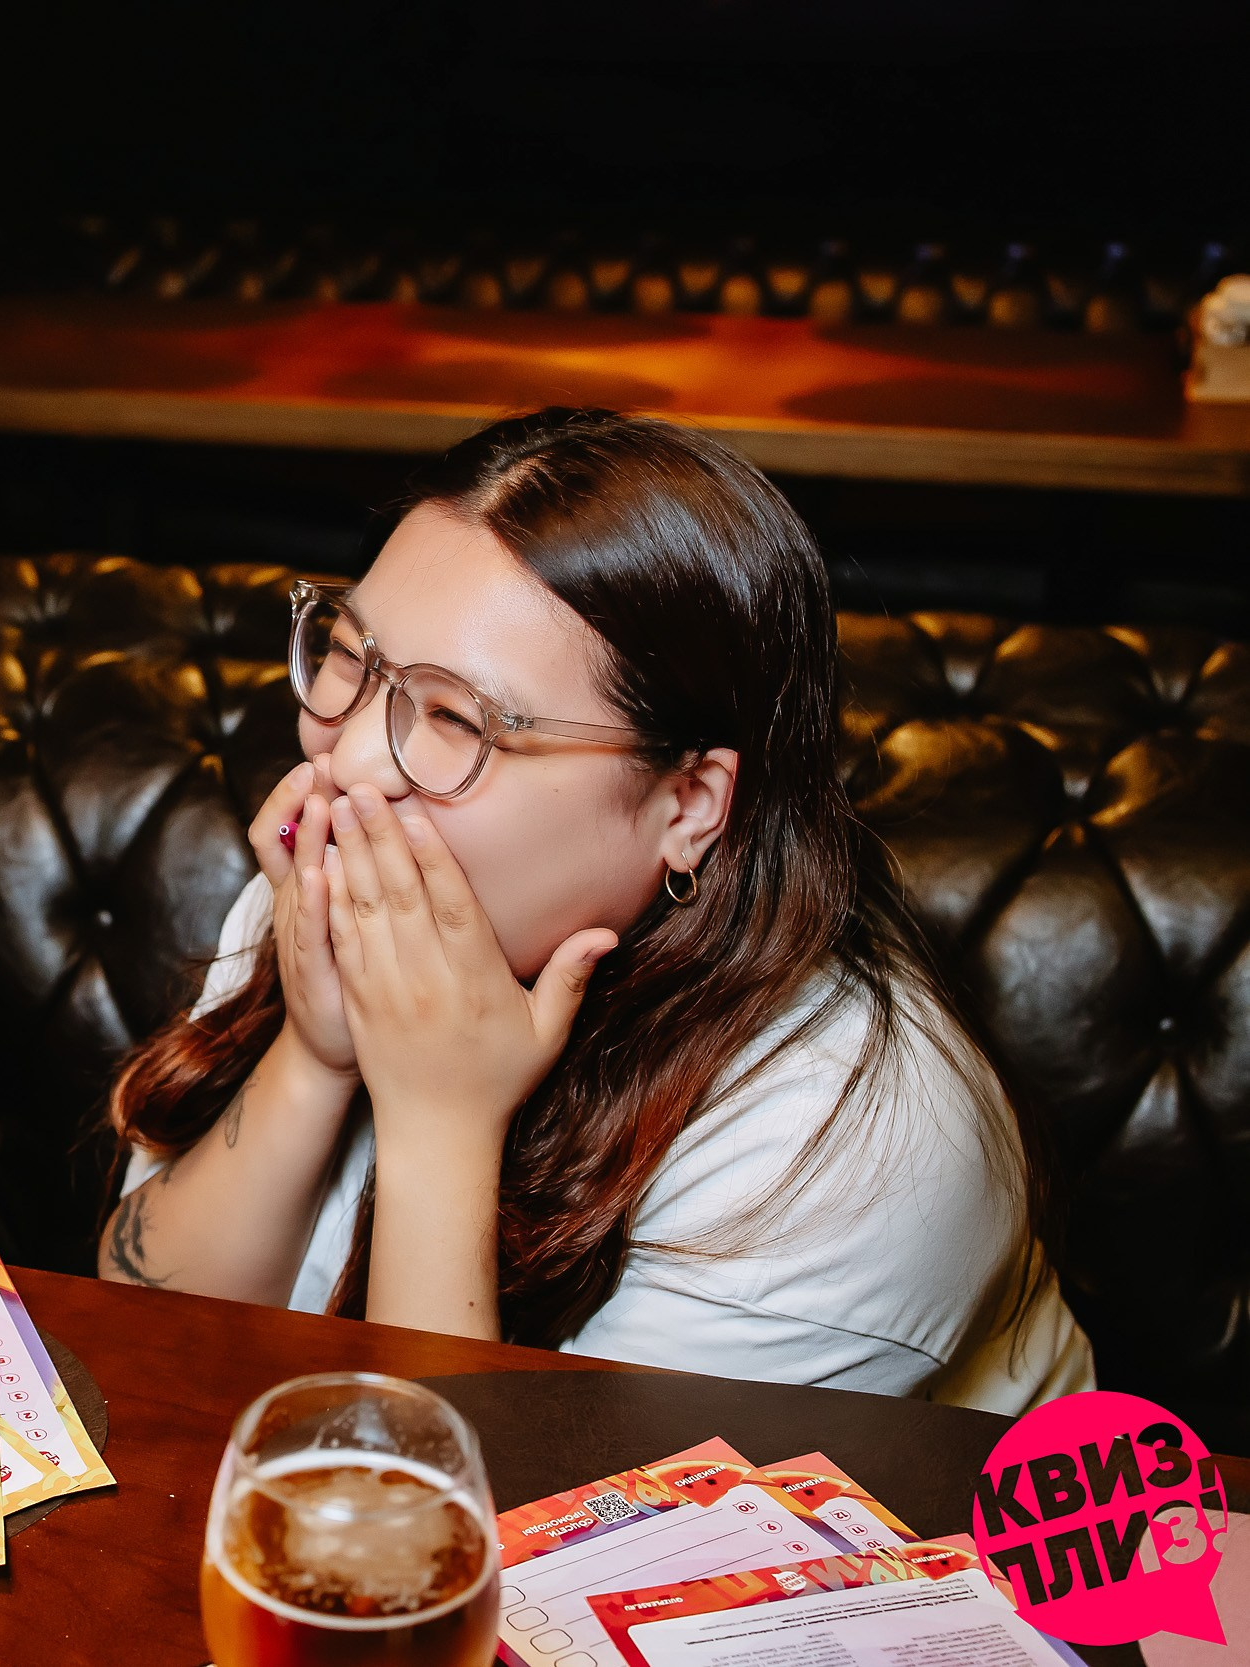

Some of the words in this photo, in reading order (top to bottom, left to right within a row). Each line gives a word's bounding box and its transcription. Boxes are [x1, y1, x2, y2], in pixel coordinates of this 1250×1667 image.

[674, 1464, 726, 1487] #КВИЗПЛИЗ
[738, 1503, 755, 1512] 10
[522, 1510, 586, 1536] ПРОМОКОДЫ
[545, 1517, 594, 1538] СОЦСЕТИ,
[911, 1551, 955, 1564] #КВИЗПЛИЗ
[624, 1597, 683, 1611] QUIZPLEASE.RU
